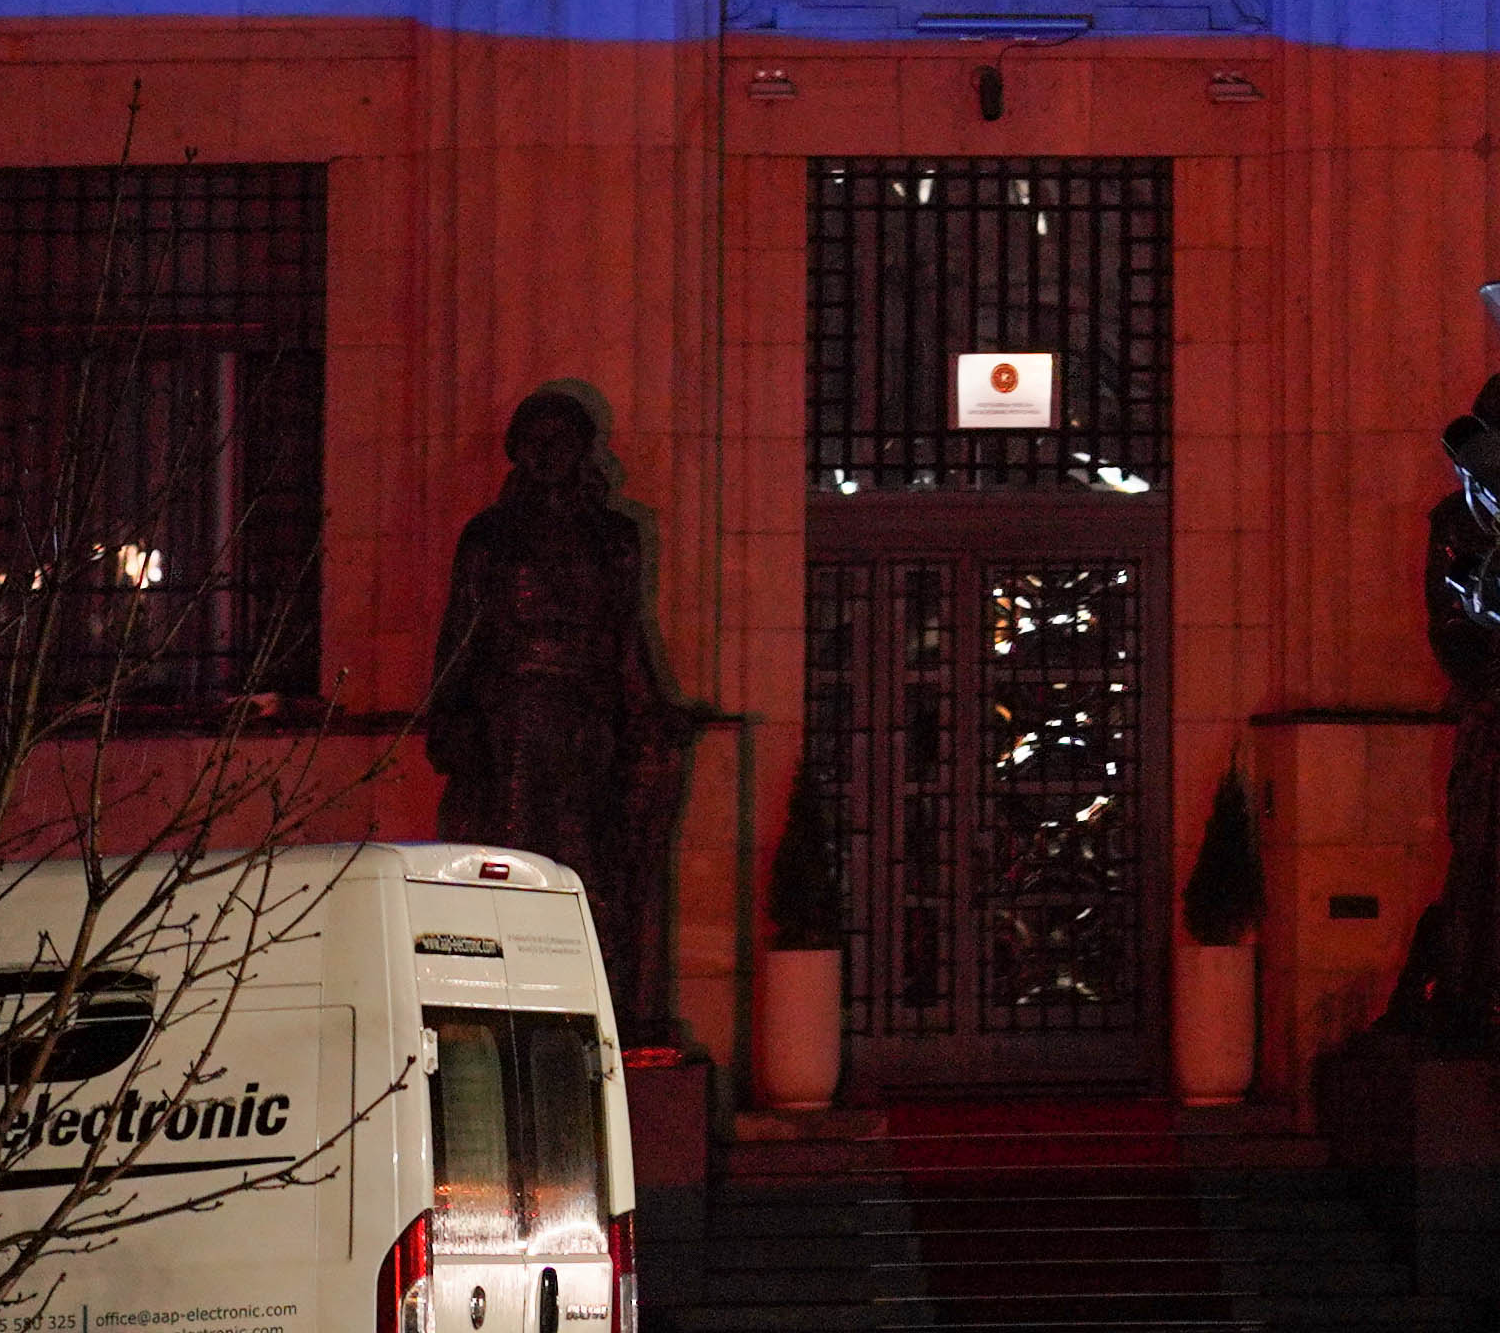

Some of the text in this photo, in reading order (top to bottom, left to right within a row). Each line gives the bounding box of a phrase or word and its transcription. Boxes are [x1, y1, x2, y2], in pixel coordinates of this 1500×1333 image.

[0, 1082, 292, 1151] electronic
[48, 1315, 77, 1330] 325
[95, 1302, 298, 1328] office@aap-electronic.com
